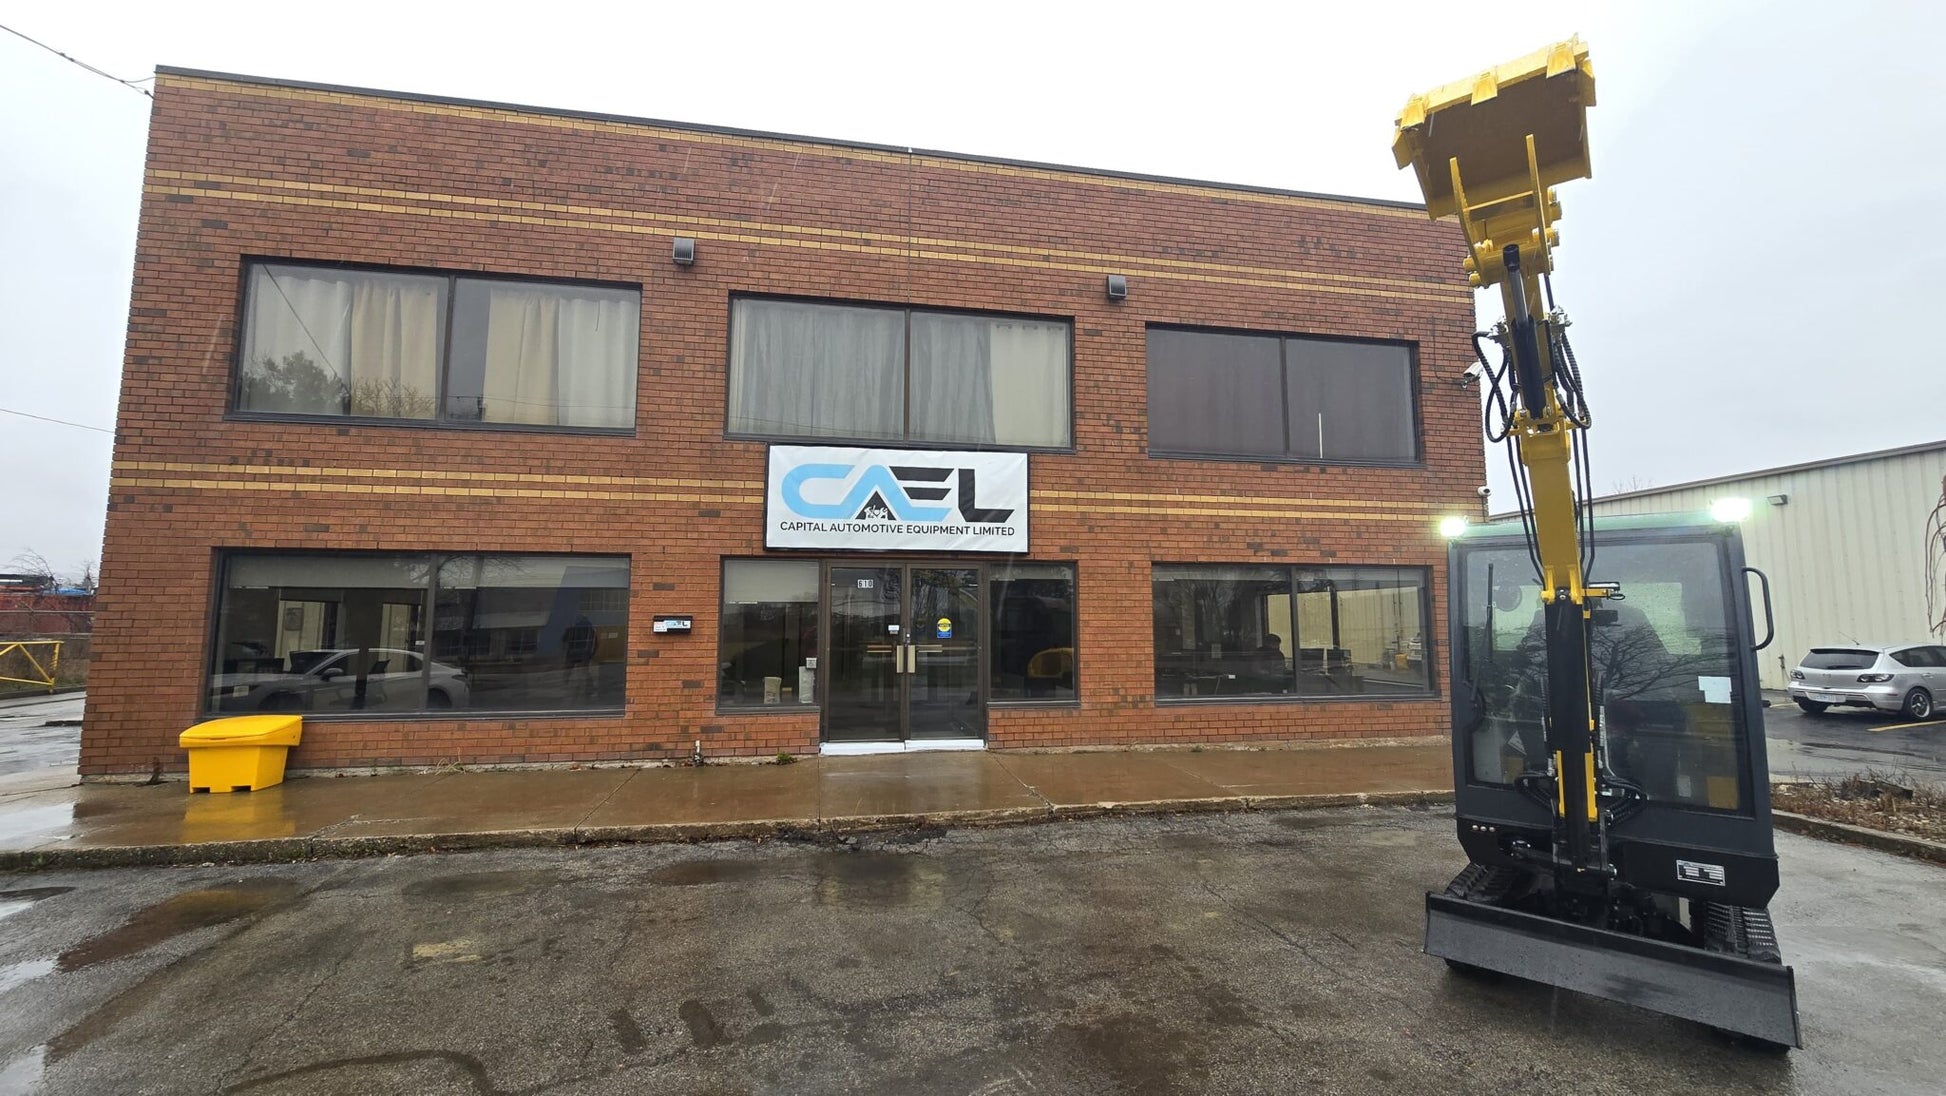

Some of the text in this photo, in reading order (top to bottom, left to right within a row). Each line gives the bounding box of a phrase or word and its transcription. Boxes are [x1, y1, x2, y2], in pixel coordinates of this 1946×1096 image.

[781, 463, 1015, 523] CAEL
[780, 521, 1015, 536] CAPITAL AUTOMOTIVE EQUIPMENT LIMITED
